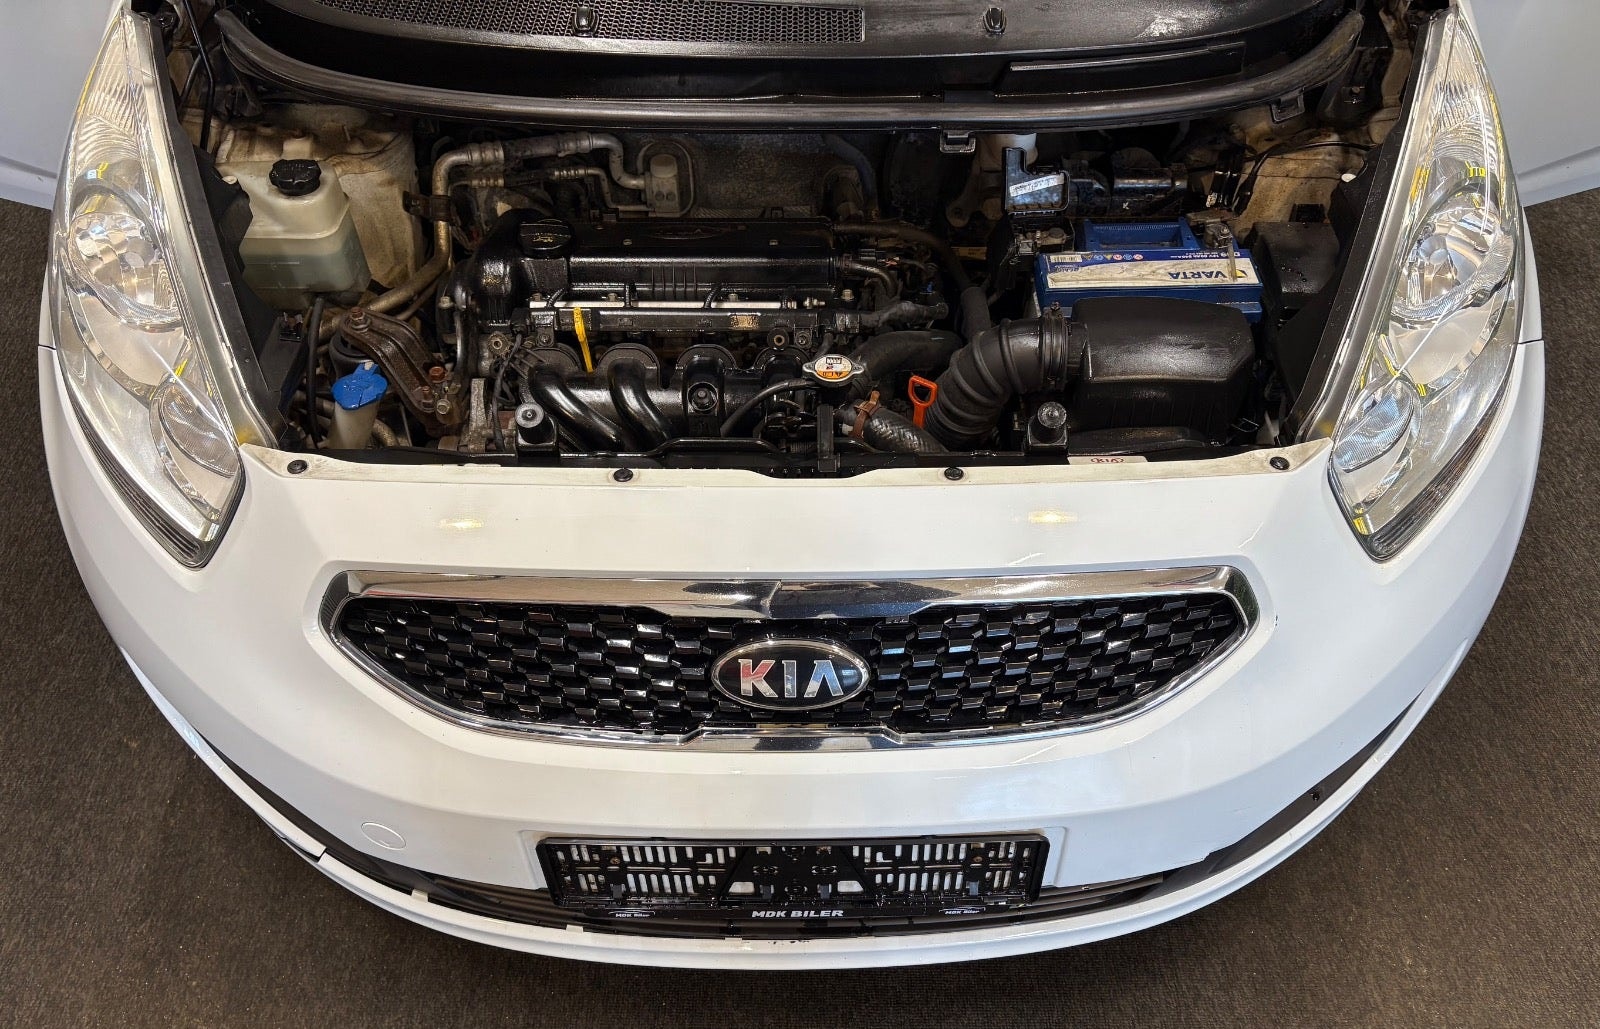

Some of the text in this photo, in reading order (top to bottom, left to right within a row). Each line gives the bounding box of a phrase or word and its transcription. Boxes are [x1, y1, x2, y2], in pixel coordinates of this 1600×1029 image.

[1168, 270, 1227, 280] VARTA
[738, 658, 844, 699] KIA
[751, 909, 844, 918] MDK BILER
